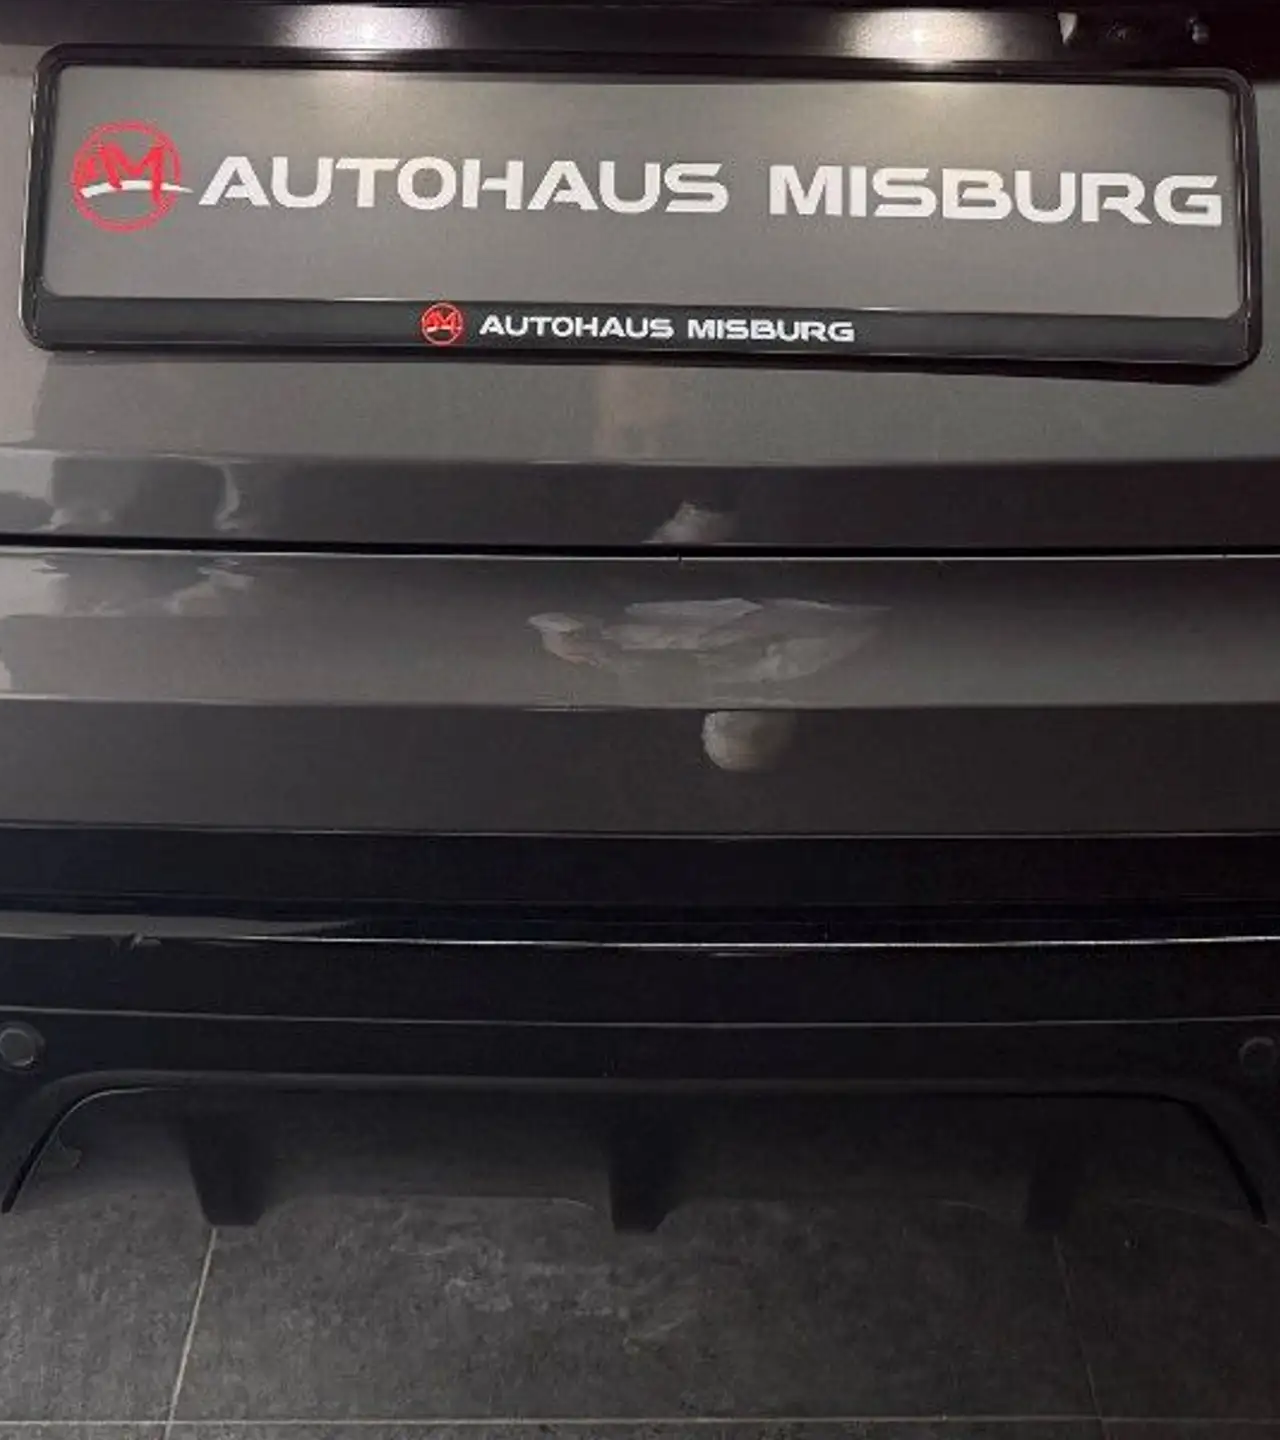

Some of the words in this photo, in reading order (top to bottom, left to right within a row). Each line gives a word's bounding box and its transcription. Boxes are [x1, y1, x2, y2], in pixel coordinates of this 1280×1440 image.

[199, 155, 728, 213] AUTOHAUS
[770, 164, 1222, 225] MISBURG
[479, 314, 675, 340] AUTOHAUS
[688, 318, 855, 343] MISBURG
